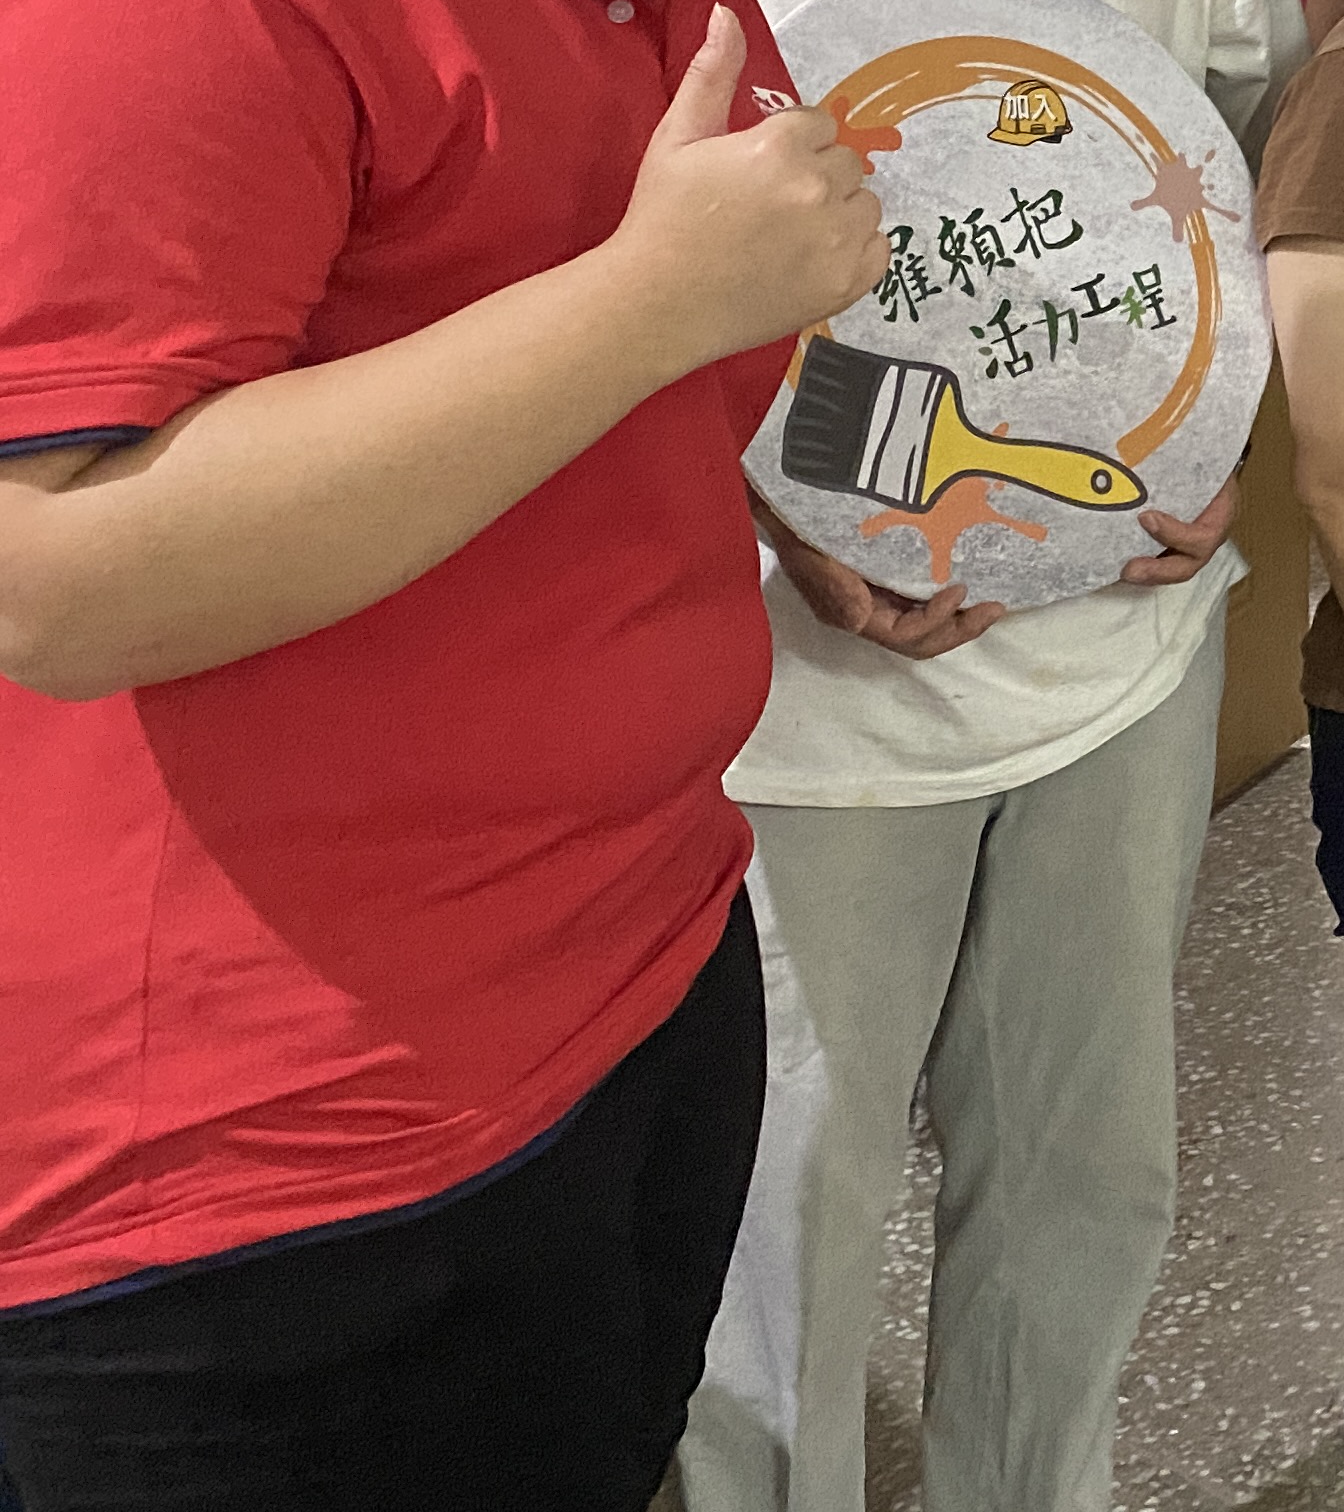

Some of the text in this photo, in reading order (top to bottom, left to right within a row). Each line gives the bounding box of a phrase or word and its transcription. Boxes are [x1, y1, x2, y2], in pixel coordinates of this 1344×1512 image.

[1003, 92, 1058, 121] 加入
[969, 263, 1177, 379] 活力工程
